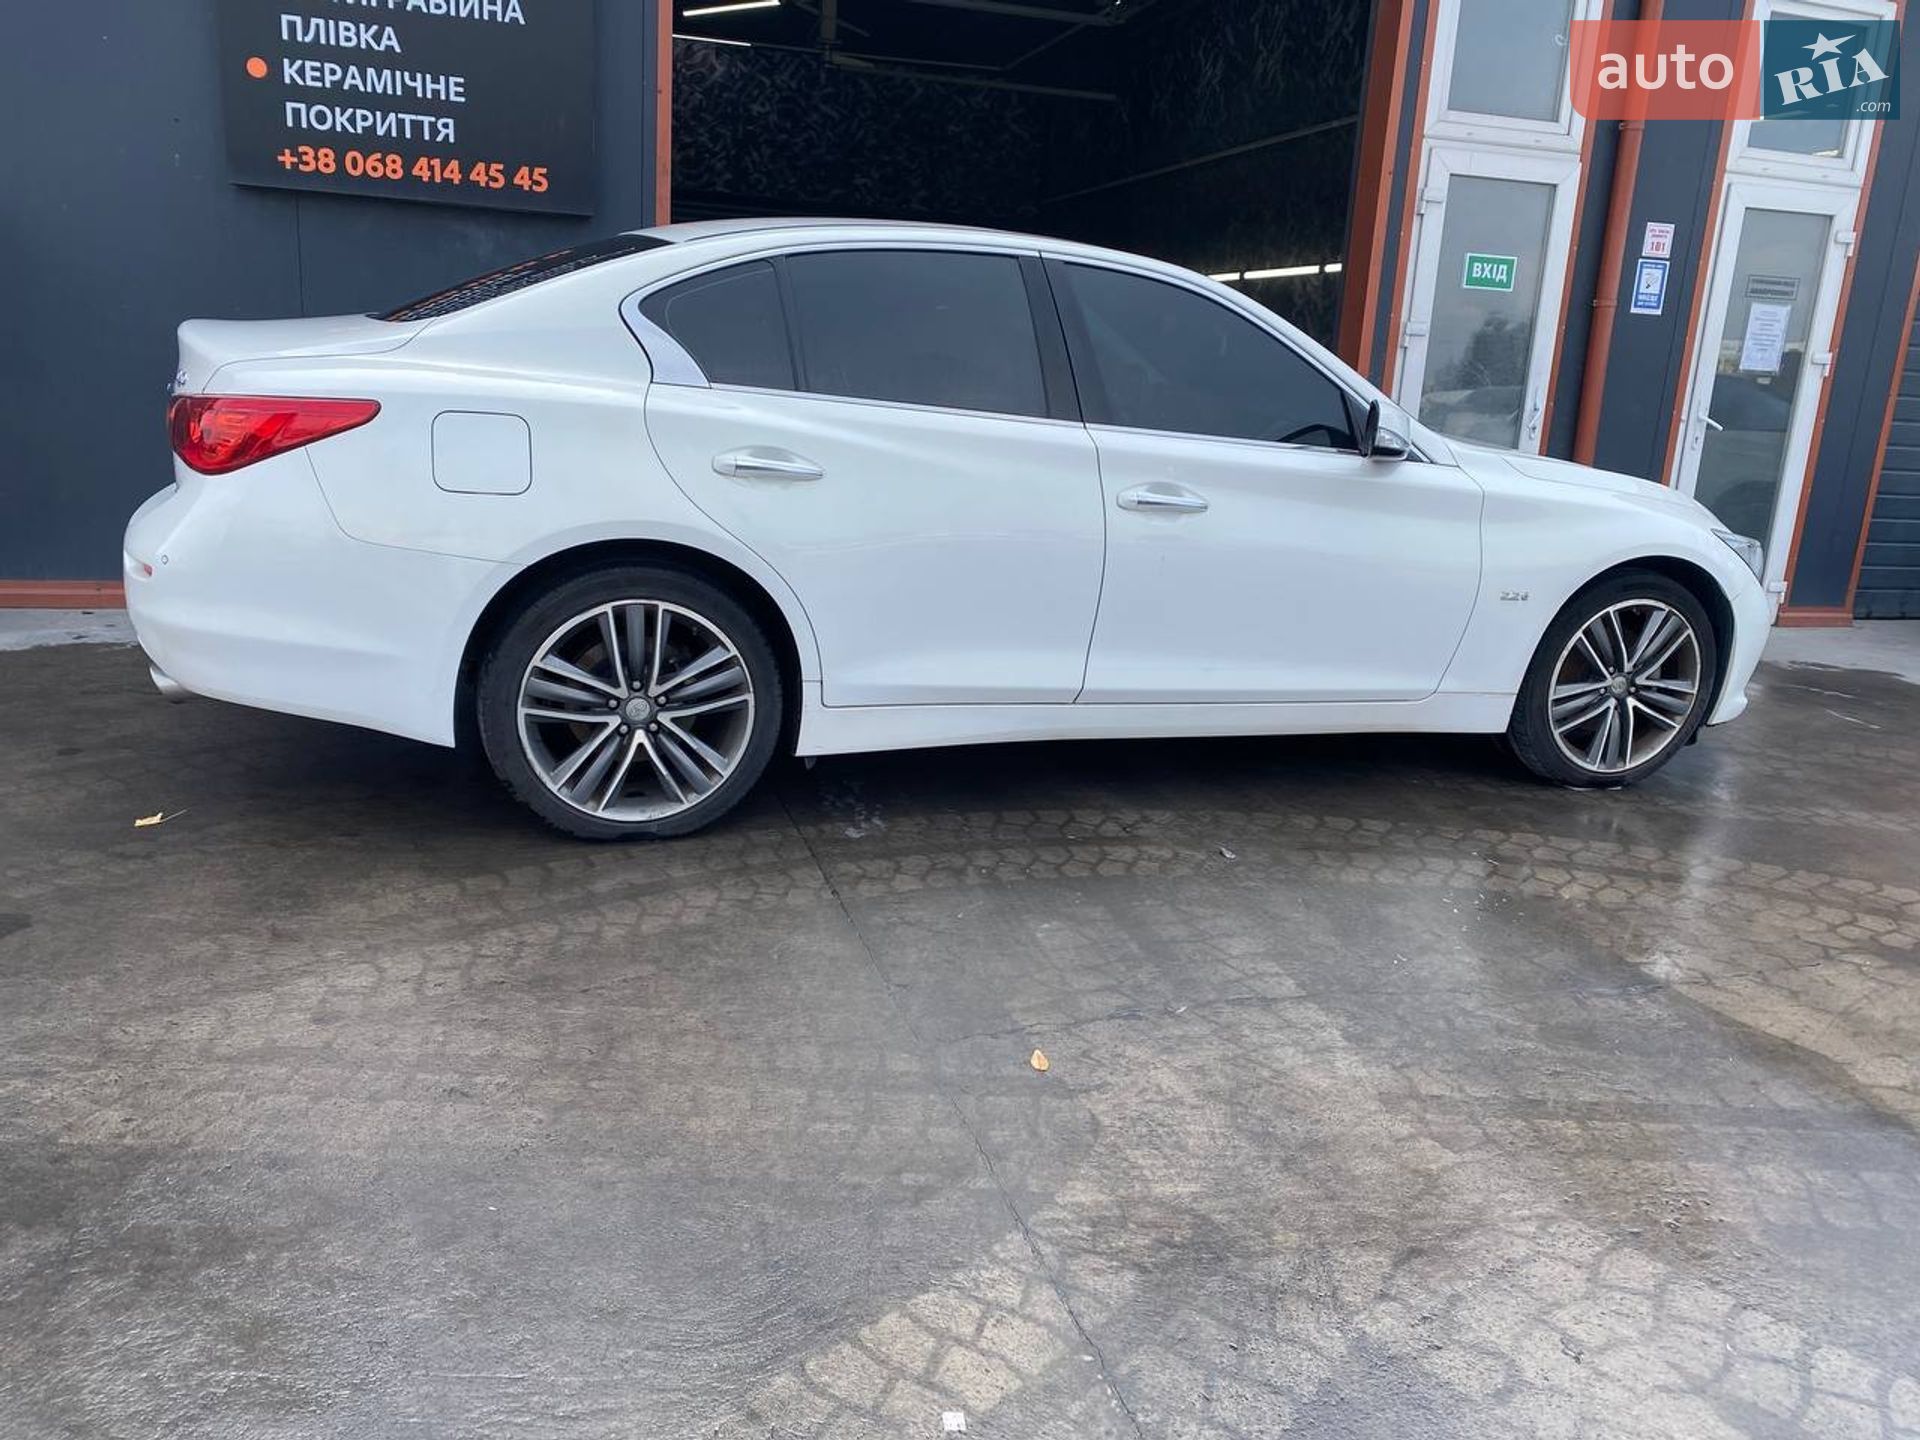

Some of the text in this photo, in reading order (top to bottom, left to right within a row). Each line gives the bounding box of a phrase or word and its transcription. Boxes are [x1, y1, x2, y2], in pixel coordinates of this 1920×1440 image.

[281, 14, 402, 53] ПЛІВКА
[282, 58, 466, 102] КЕРАМІЧНЕ
[285, 101, 456, 143] ПОКРИТТЯ
[277, 145, 549, 192] +38 068 414 45 45
[1472, 262, 1508, 283] ВХІД
